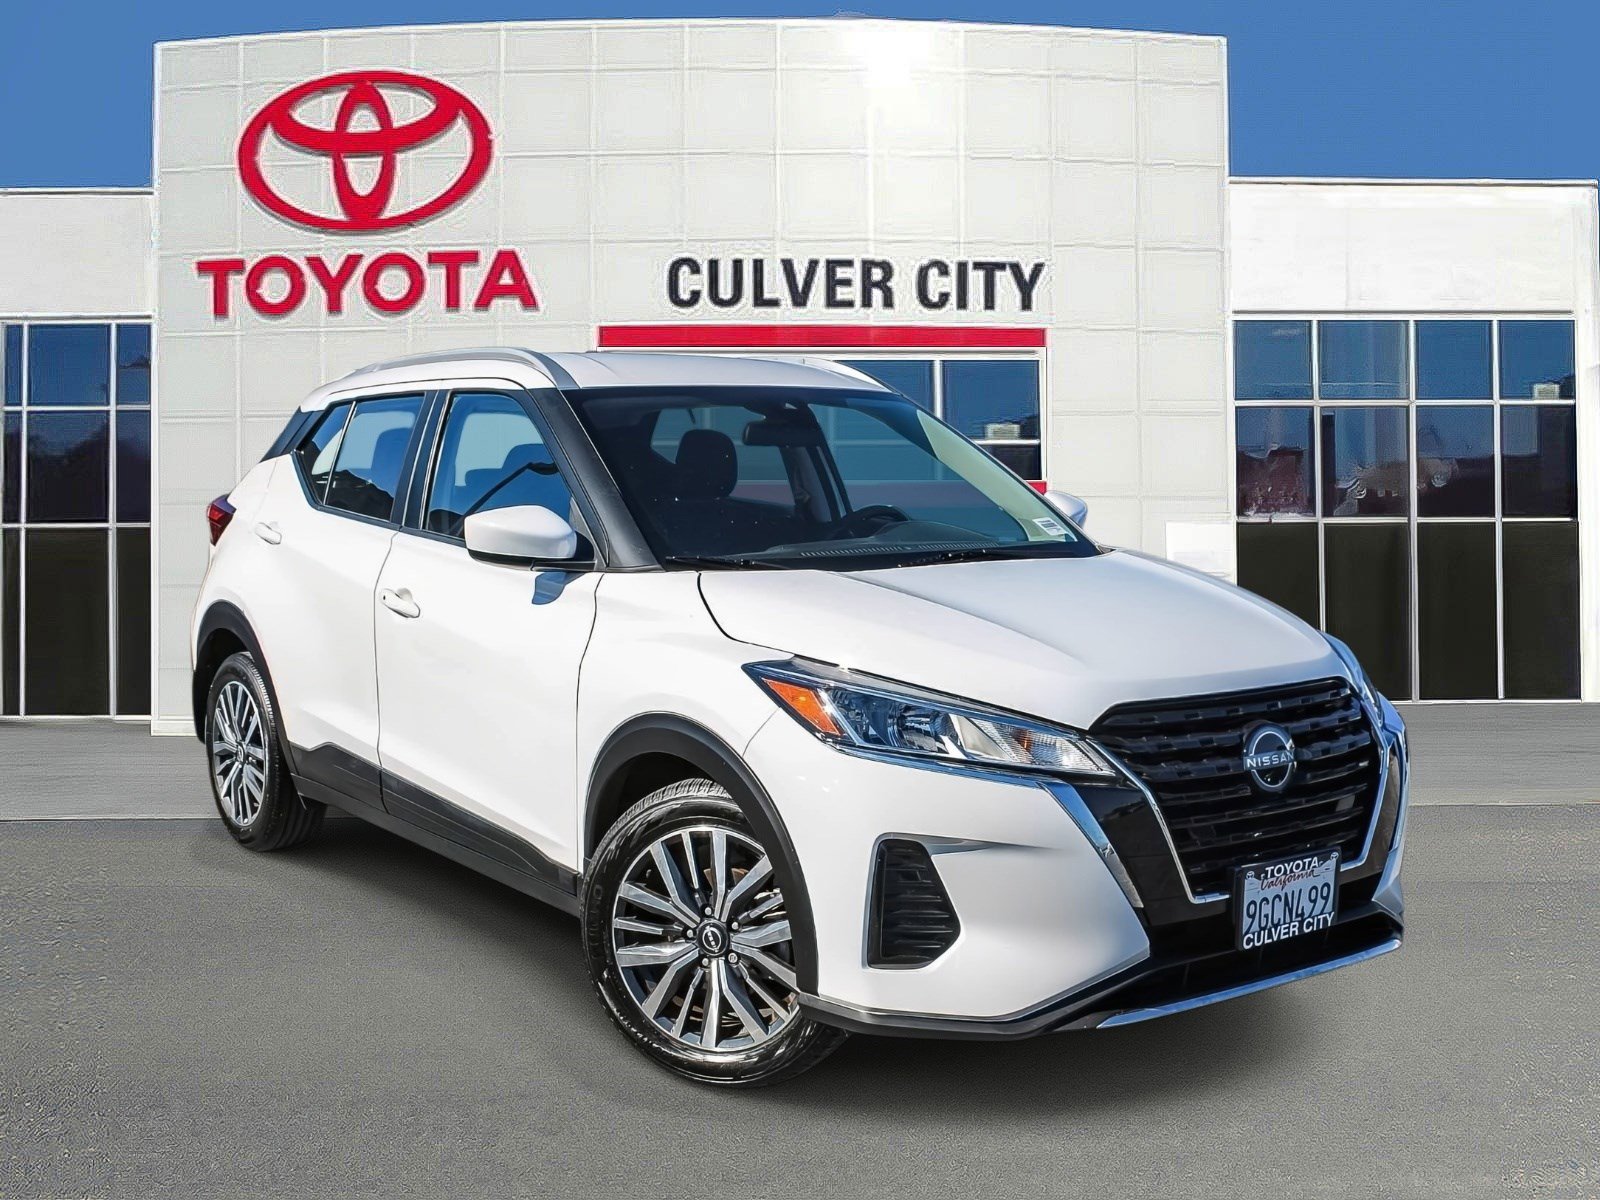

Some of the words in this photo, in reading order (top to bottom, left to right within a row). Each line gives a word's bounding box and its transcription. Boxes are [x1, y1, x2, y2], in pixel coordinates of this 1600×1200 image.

[196, 249, 539, 319] TOYOTA
[667, 257, 895, 310] CULVER
[915, 259, 1045, 311] CITY
[1246, 750, 1294, 768] NISSAN
[1260, 869, 1320, 891] California
[1265, 856, 1318, 878] TOYOTA
[1243, 882, 1331, 934] 9GCN499
[1243, 921, 1299, 950] CULVER
[1303, 911, 1335, 933] CITY
